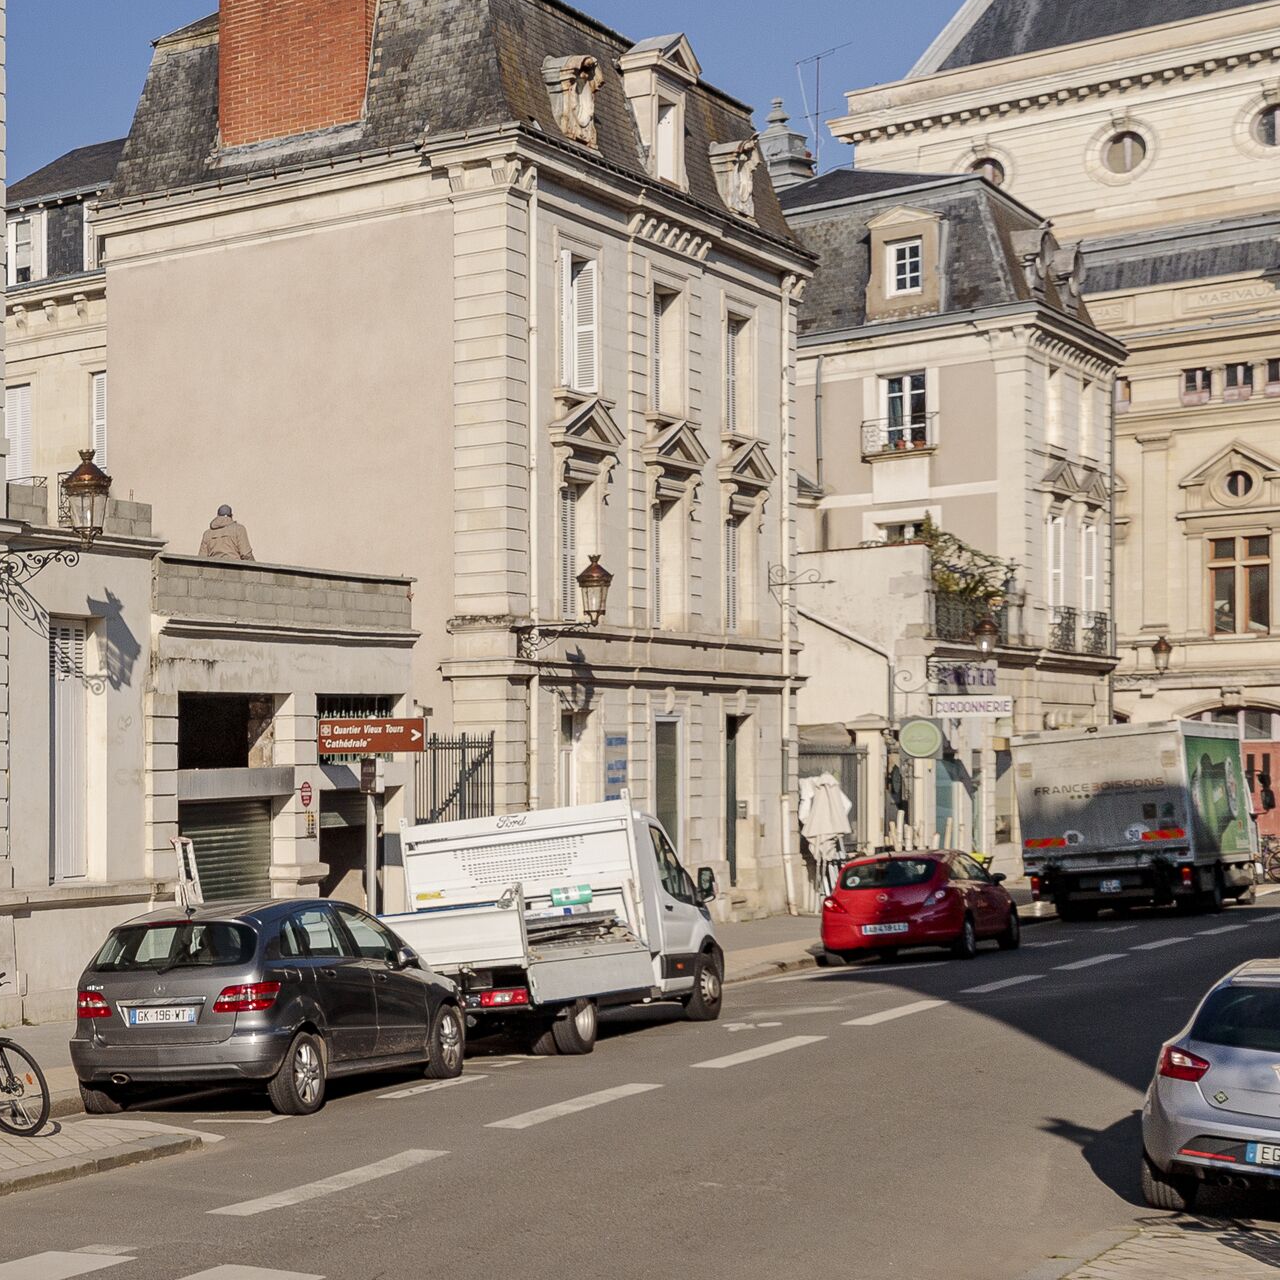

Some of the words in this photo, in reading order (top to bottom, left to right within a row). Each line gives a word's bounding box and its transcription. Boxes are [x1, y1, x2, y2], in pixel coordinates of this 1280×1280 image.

[1198, 285, 1276, 304] MARIVAUX
[333, 725, 361, 735] Quartier
[363, 725, 382, 734] Vieux
[385, 724, 404, 733] Tours
[496, 815, 527, 828] Ford
